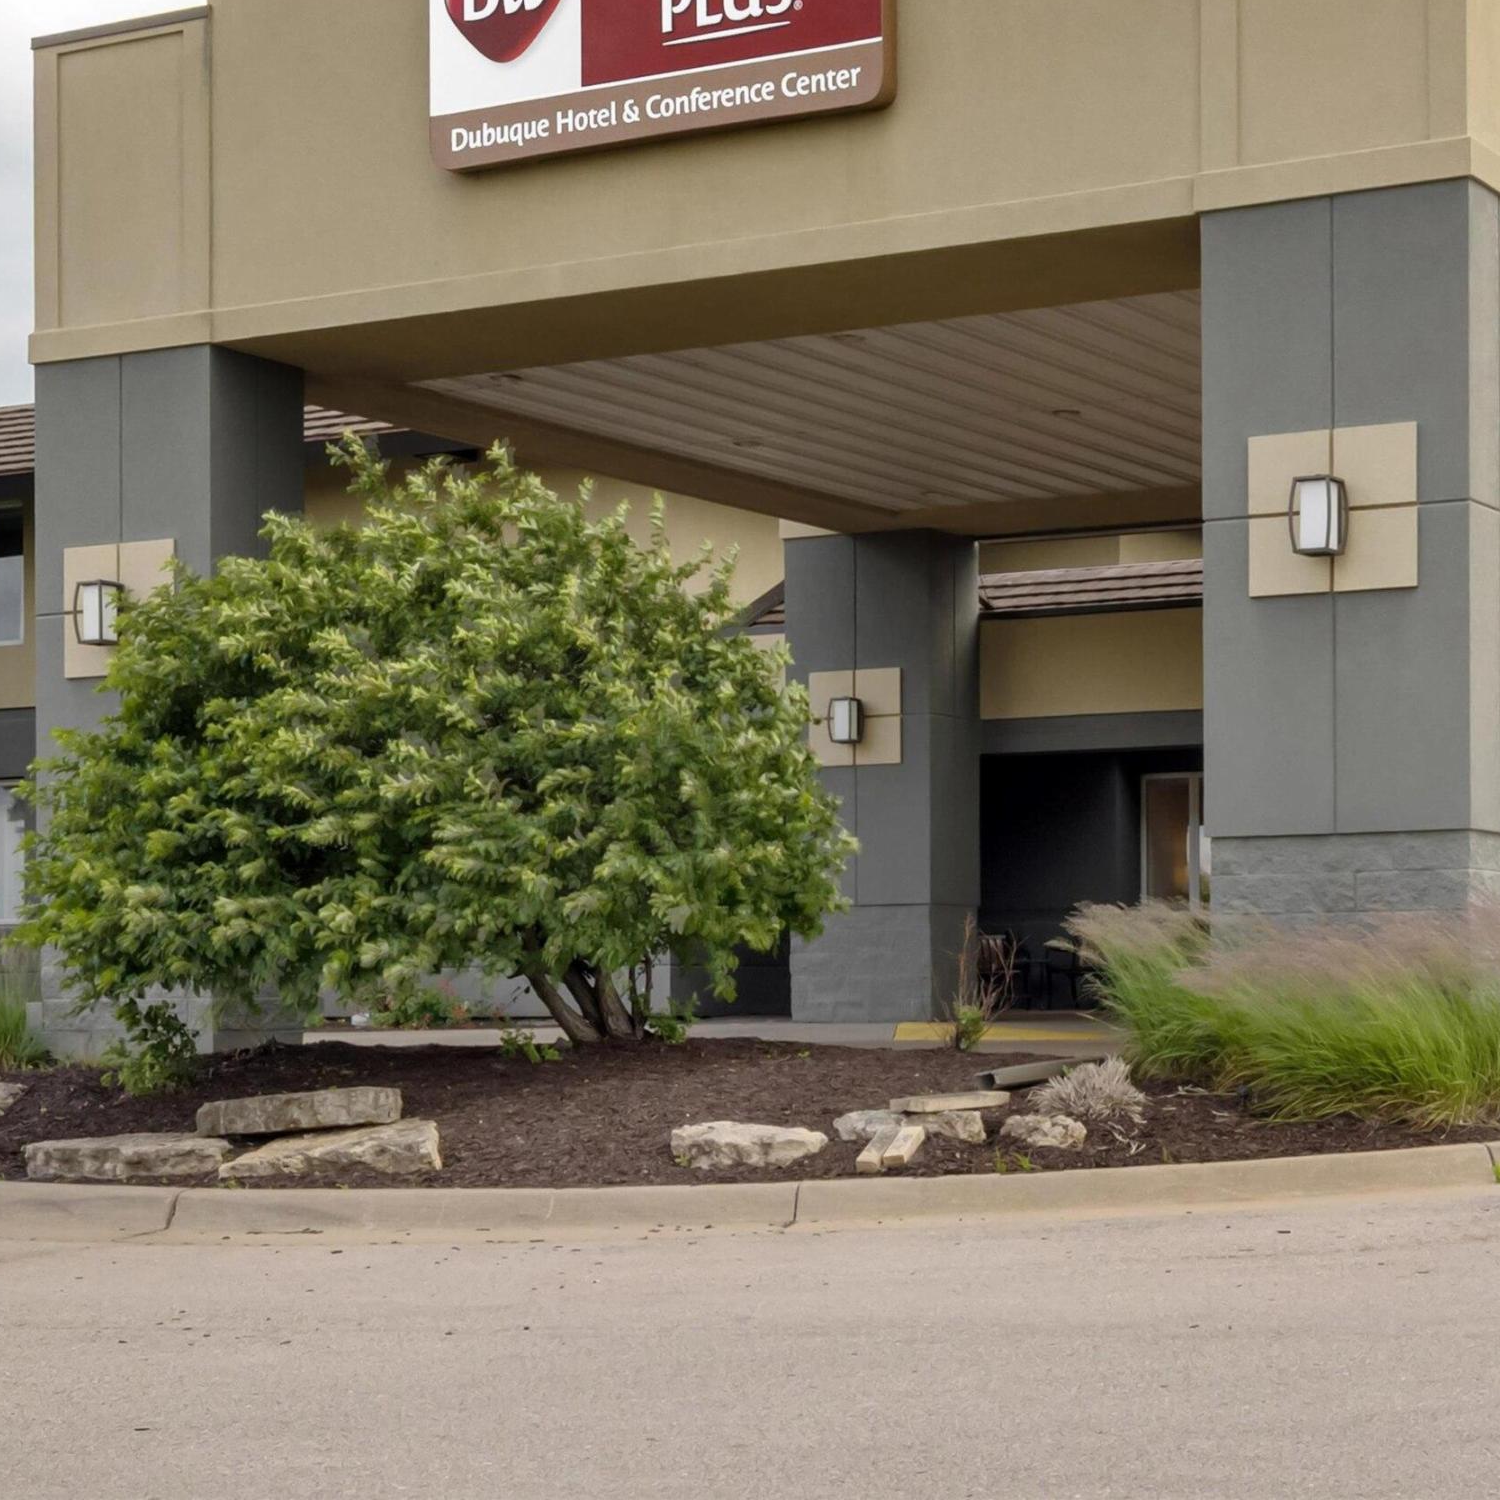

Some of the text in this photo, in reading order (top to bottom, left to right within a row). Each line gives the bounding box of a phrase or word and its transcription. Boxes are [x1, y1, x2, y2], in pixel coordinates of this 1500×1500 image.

[450, 64, 862, 152] Dubuque Hotel & Conference Center
